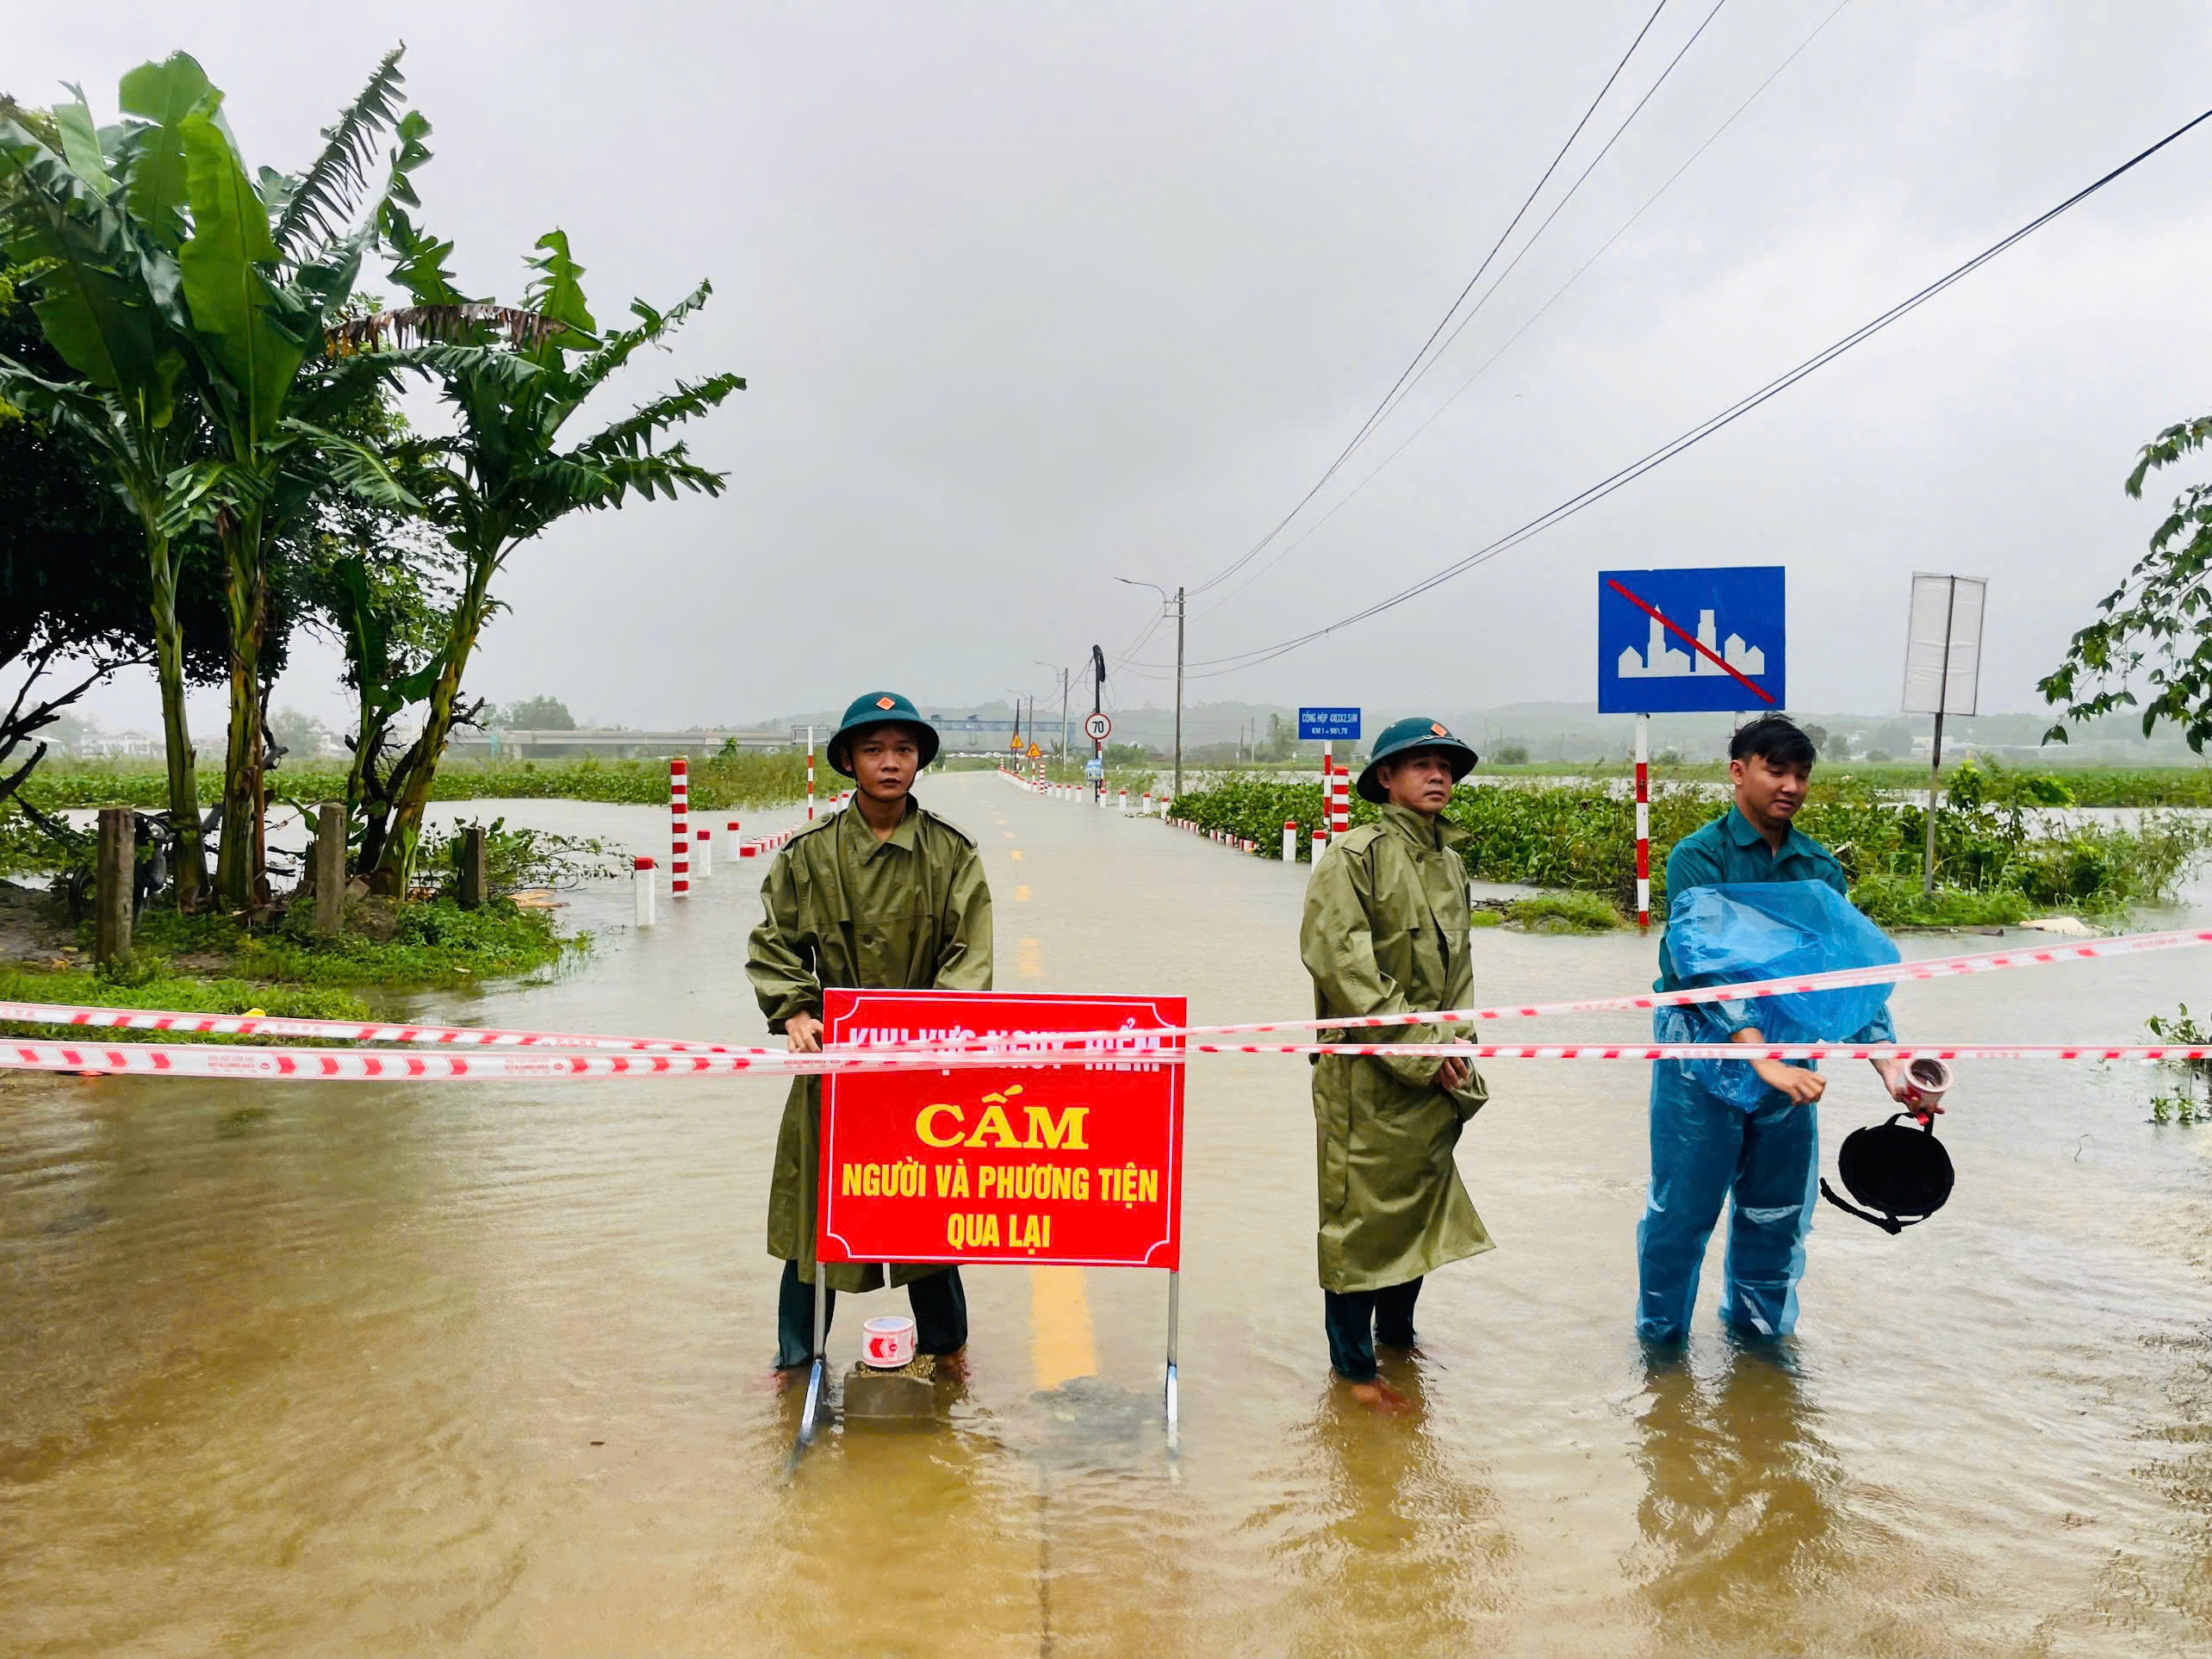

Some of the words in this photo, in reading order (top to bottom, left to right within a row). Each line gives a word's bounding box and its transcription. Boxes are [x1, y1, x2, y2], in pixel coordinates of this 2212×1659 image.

[1092, 721, 1104, 733] 70
[916, 1084, 1089, 1150] CẤM
[842, 1156, 926, 1197] NGƯỜI
[935, 1159, 969, 1198] VÀ
[979, 1163, 1090, 1200] PHƯƠNG
[1098, 1162, 1158, 1209] TIỆN
[948, 1213, 1000, 1250] QUA
[1009, 1215, 1051, 1255] LẠI
